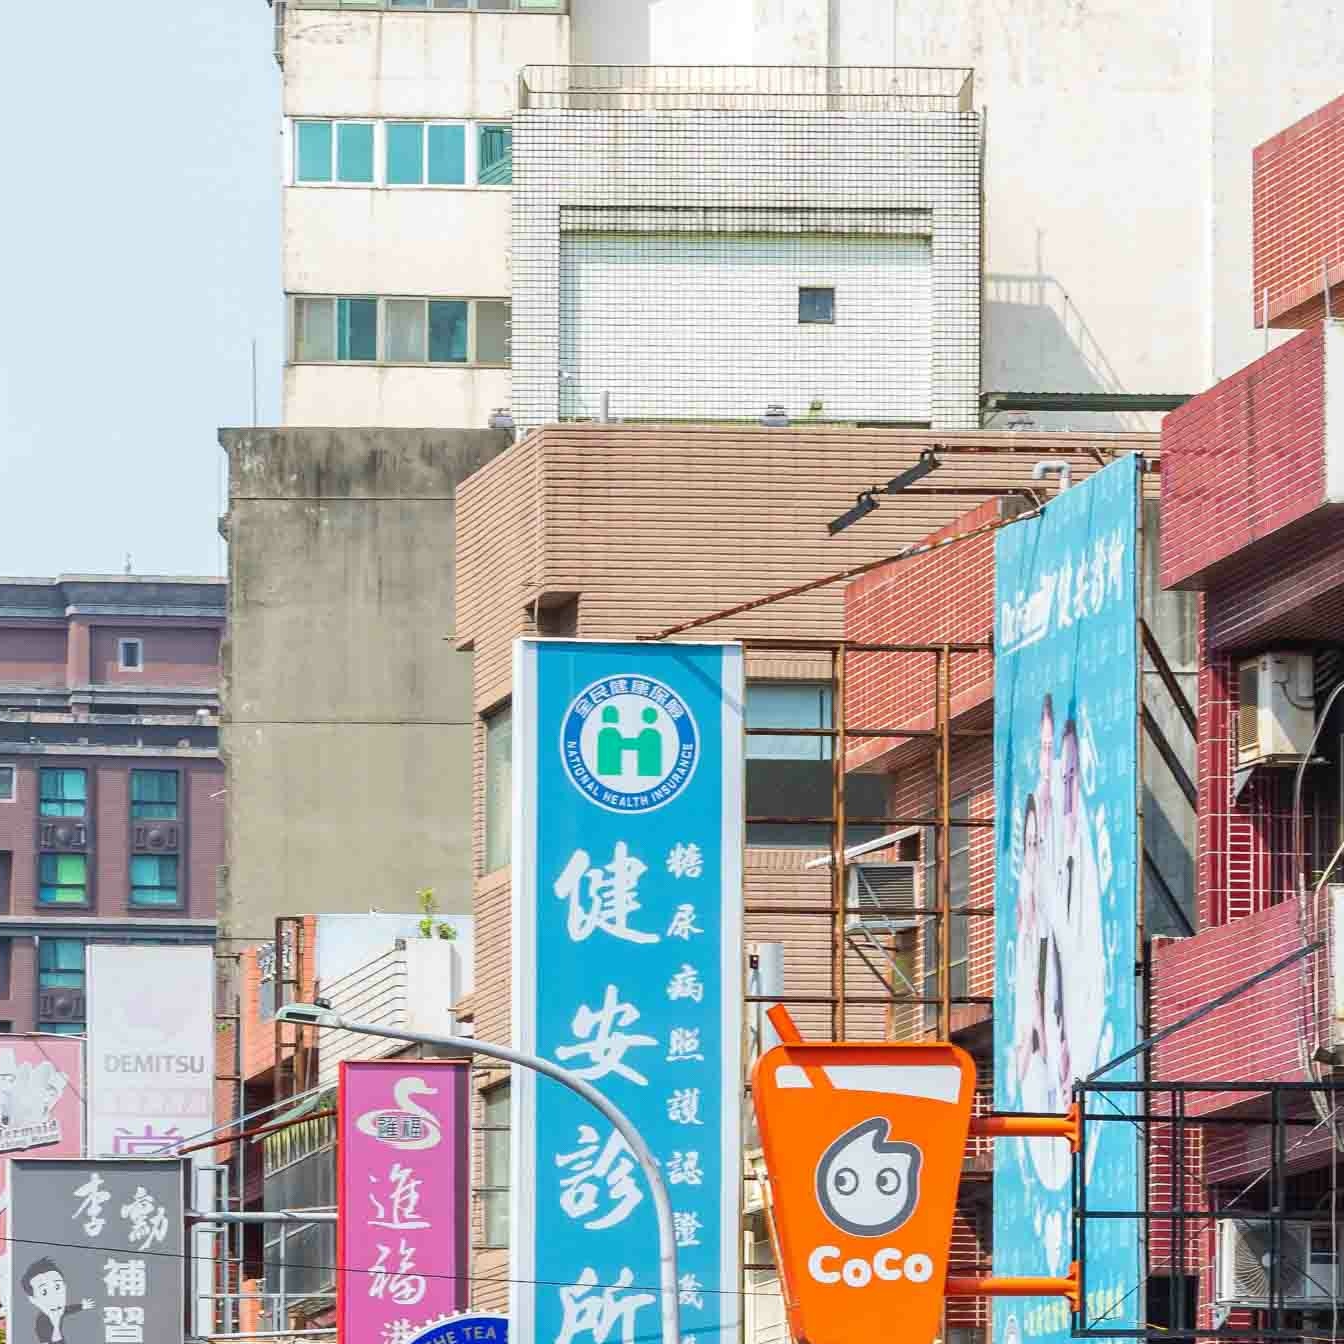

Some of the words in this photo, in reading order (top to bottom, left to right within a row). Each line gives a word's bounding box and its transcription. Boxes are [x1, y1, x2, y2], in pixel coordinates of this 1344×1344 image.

[574, 679, 685, 720] 全民健康保險
[567, 741, 601, 796] NATIONAL
[603, 793, 649, 808] HEALTH
[651, 743, 694, 802] INSURANCE
[807, 1245, 934, 1288] CoCo
[462, 1326, 497, 1341] TEA
